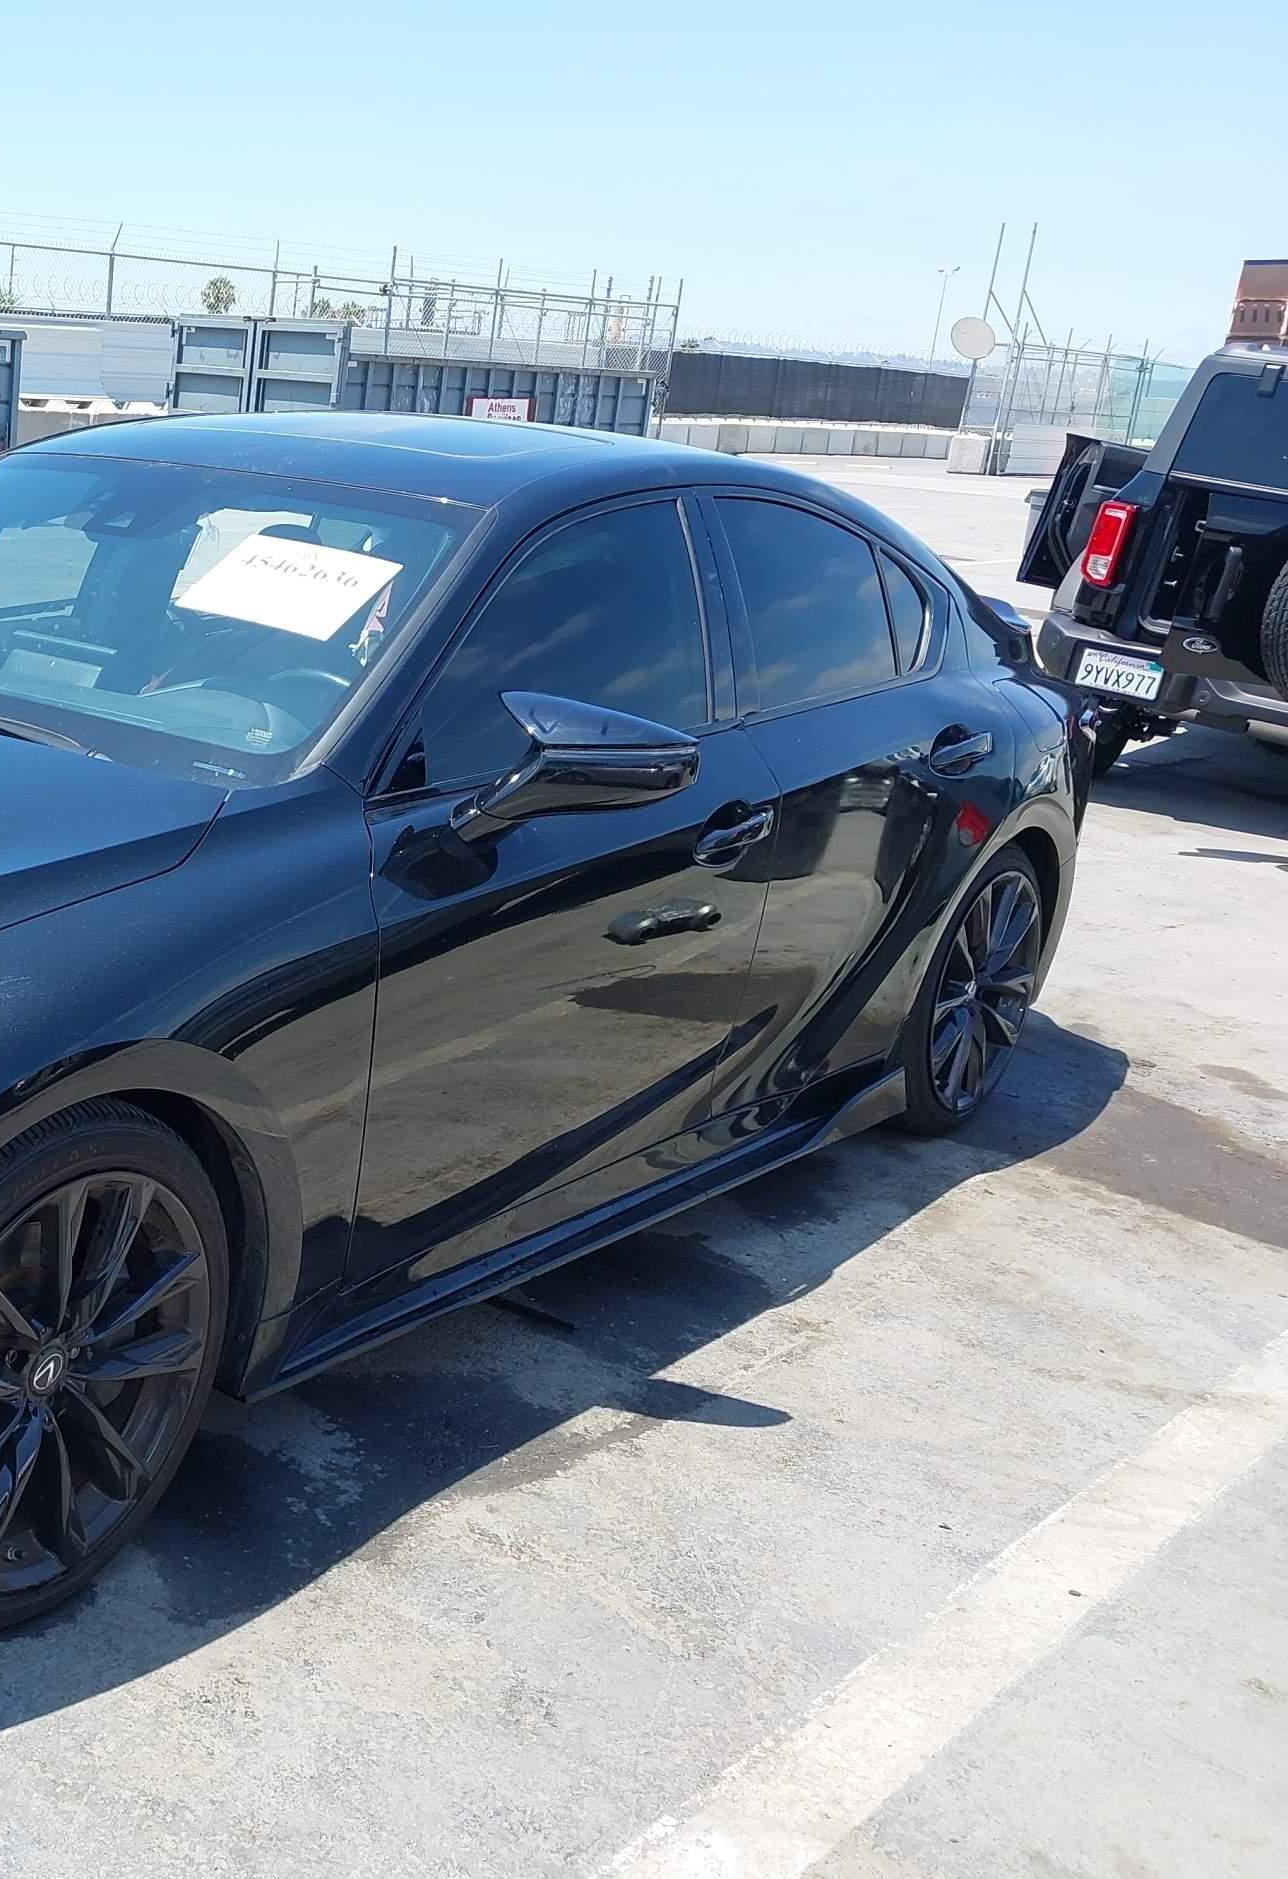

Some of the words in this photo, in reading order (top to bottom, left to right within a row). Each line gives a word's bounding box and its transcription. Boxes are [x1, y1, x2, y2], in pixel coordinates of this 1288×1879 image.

[488, 402, 517, 413] Athens
[1099, 652, 1146, 670] California
[1080, 663, 1157, 695] 9YVX977
